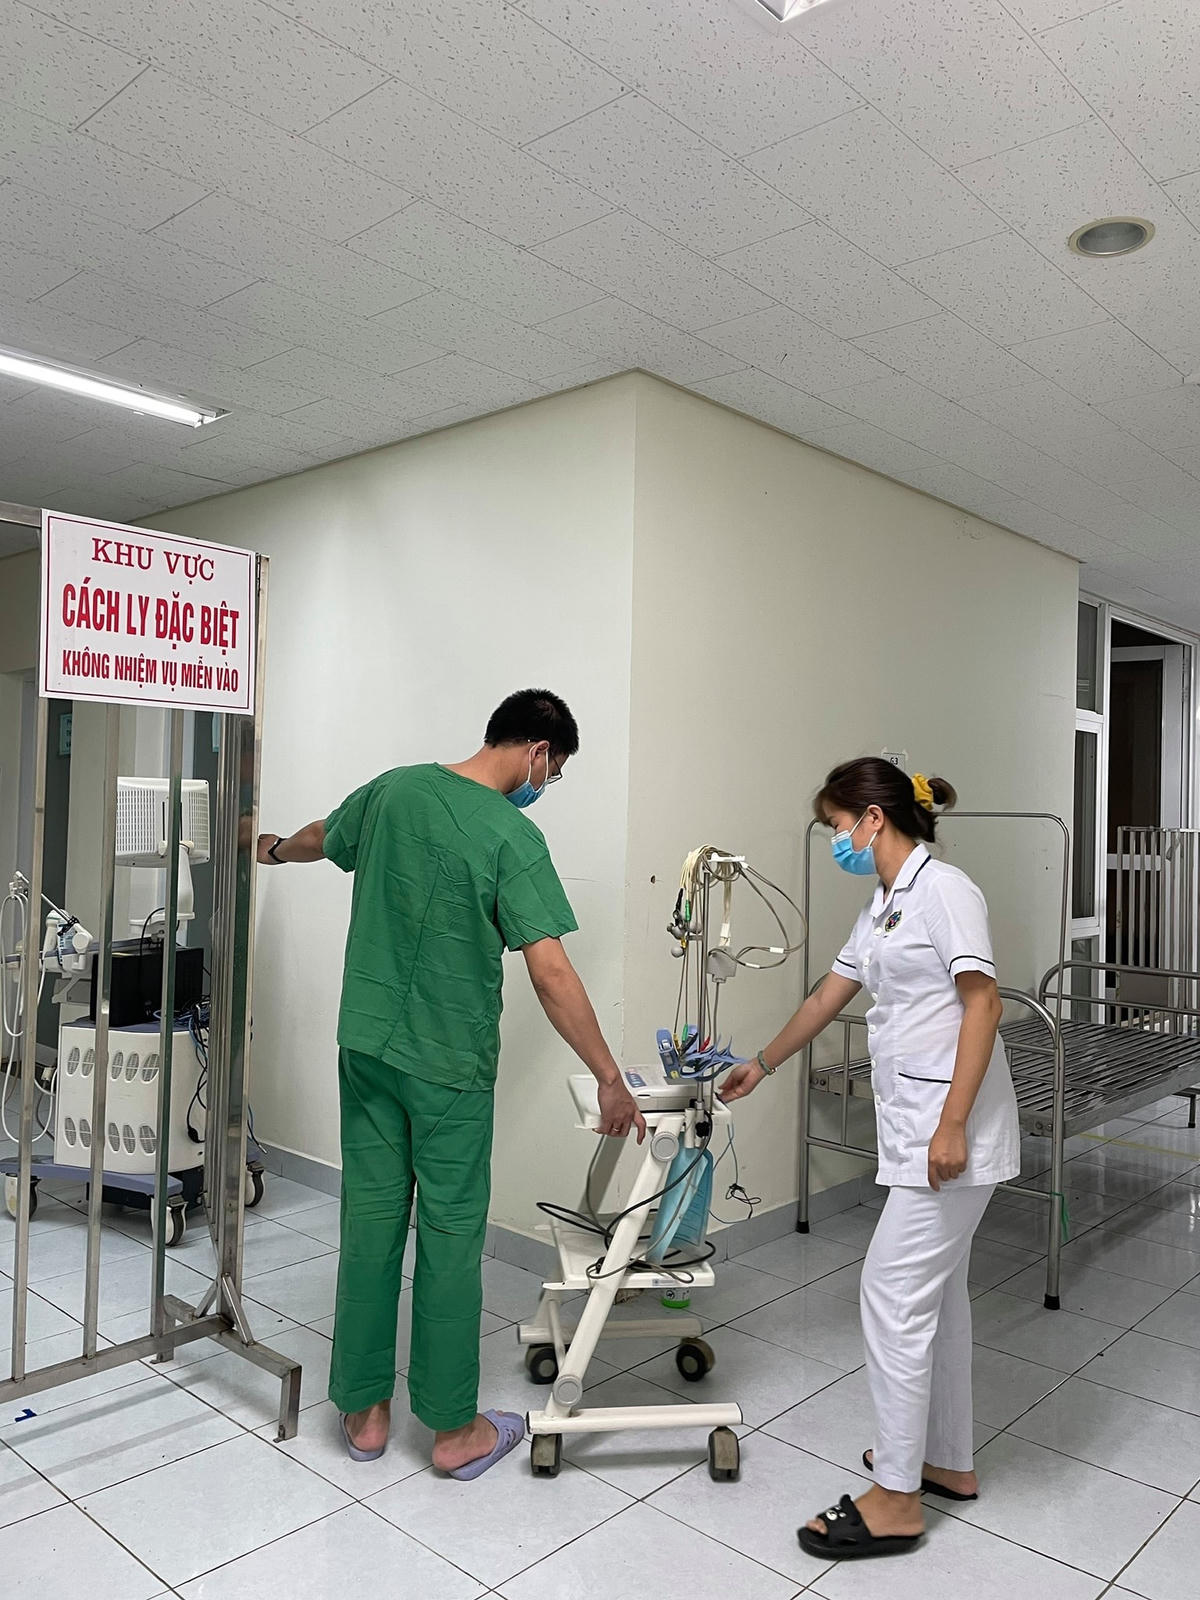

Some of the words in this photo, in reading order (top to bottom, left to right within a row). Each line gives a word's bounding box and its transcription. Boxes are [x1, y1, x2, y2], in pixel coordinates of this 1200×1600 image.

[91, 537, 154, 570] KHU
[163, 551, 214, 585] VỰC
[62, 576, 120, 633] CÁCH
[126, 593, 150, 637] LY
[155, 591, 195, 650] ĐẶC
[200, 600, 240, 656] BIỆT
[62, 646, 110, 680] KHÔNG
[114, 653, 157, 689] NHIỆM
[161, 660, 178, 692] VỤ
[181, 655, 213, 690] MIỄN
[216, 662, 239, 693] VÀO
